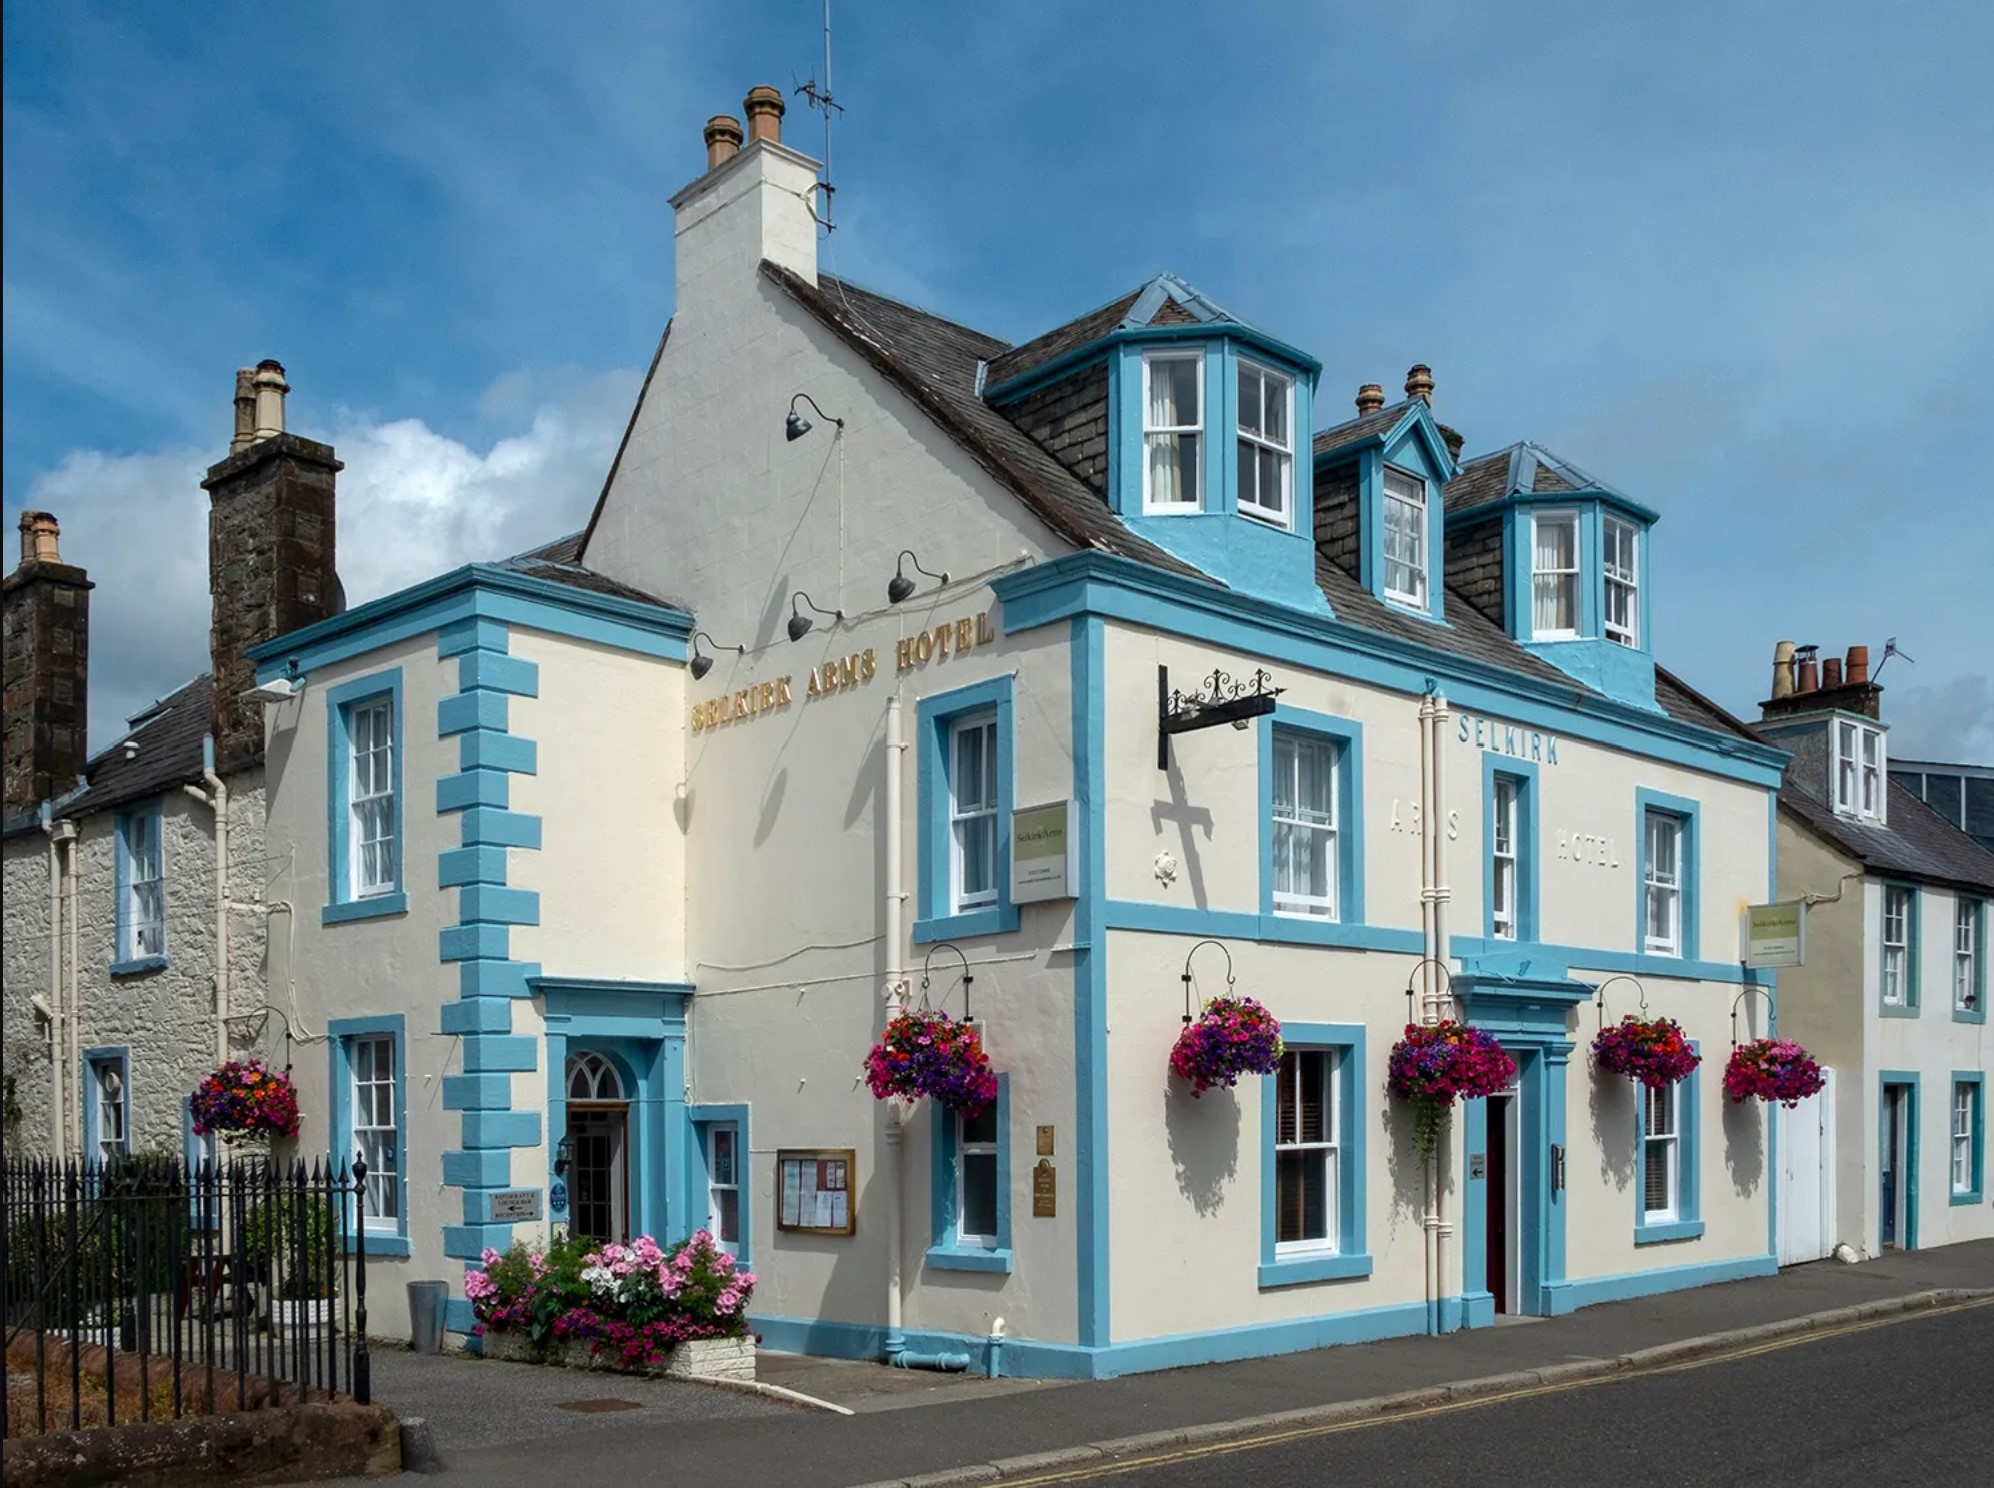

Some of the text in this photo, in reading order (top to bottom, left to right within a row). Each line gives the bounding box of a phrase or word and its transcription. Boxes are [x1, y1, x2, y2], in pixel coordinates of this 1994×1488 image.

[691, 612, 994, 731] SELKIRK ARMS HOTEL
[1458, 713, 1558, 765] SELKIRK
[1391, 798, 1459, 841] ARS
[1557, 828, 1619, 868] HOTEL
